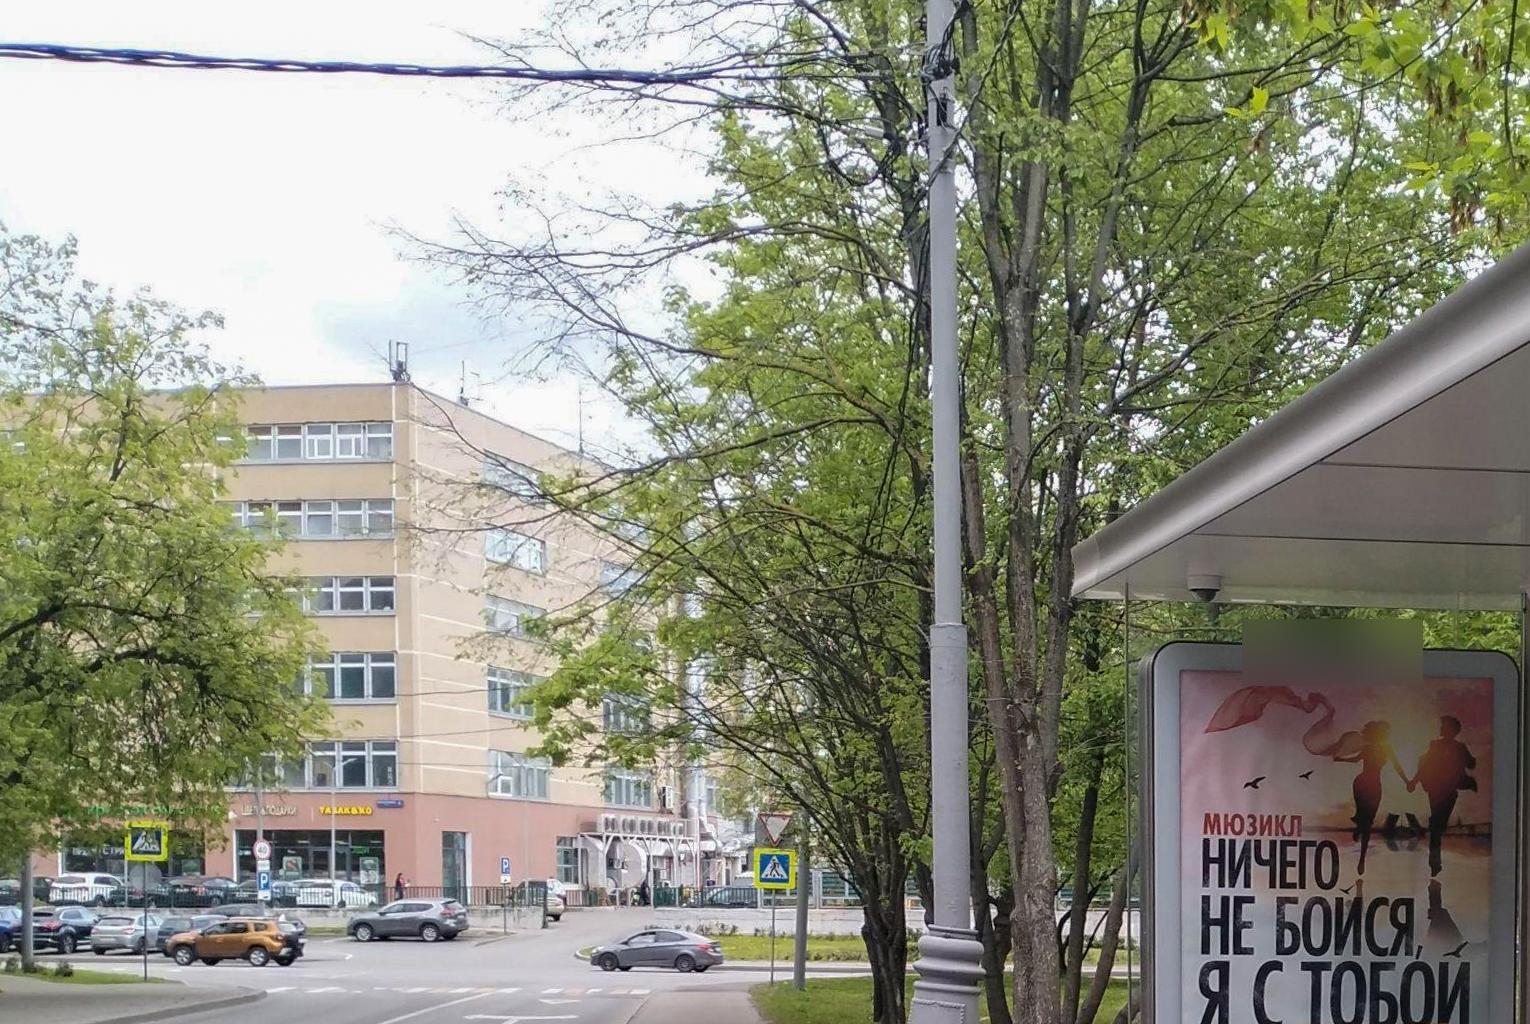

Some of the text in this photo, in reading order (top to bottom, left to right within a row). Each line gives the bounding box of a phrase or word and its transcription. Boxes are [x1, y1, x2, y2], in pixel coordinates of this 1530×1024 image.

[1203, 812, 1303, 837] МЮЗИКЛ
[1202, 837, 1340, 890] НИЧЕГО
[1200, 889, 1423, 960] НЕ БОЙСЯ,
